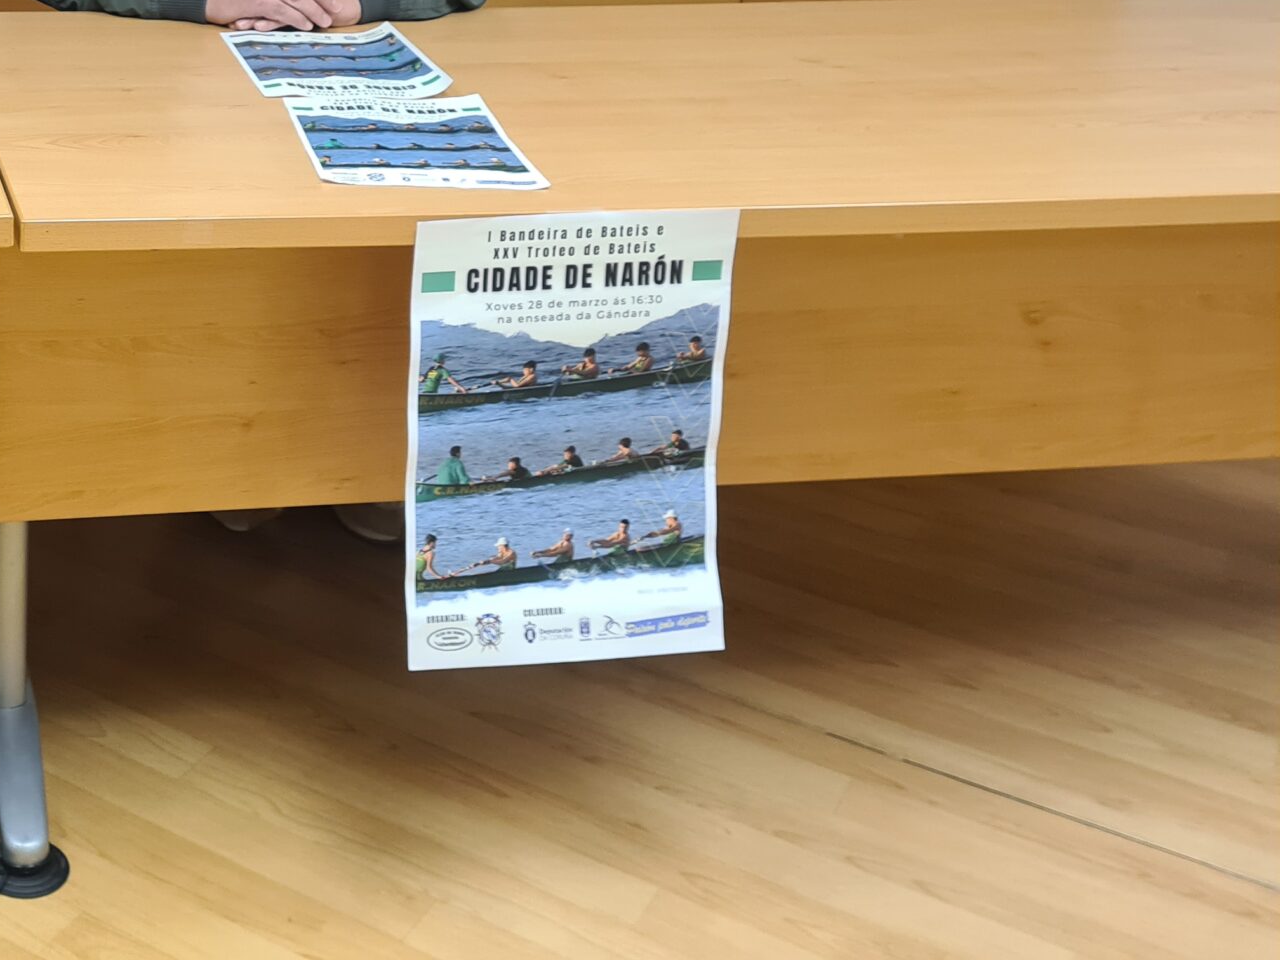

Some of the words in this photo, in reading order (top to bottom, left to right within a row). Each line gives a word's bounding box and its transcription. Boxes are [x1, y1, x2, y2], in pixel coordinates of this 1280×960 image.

[487, 230, 492, 243] I
[499, 227, 568, 242] Bandeira
[575, 226, 593, 239] de
[601, 224, 648, 238] Bateis
[656, 225, 664, 236] e
[493, 246, 519, 260] XXV
[527, 245, 575, 258] Trofeo
[583, 243, 600, 256] de
[608, 241, 656, 255] Bateis
[466, 264, 554, 293] CIDADE
[564, 263, 593, 289] DE
[604, 254, 684, 288] NARÓN
[485, 301, 524, 312] Xoves
[527, 300, 543, 310] 28
[547, 299, 563, 309] de
[568, 297, 608, 308] marzo
[612, 295, 627, 306] ás
[631, 294, 663, 305] 16:30
[497, 315, 512, 324] na
[517, 312, 571, 323] enseada
[576, 311, 592, 320] da
[596, 308, 651, 319] Gándara
